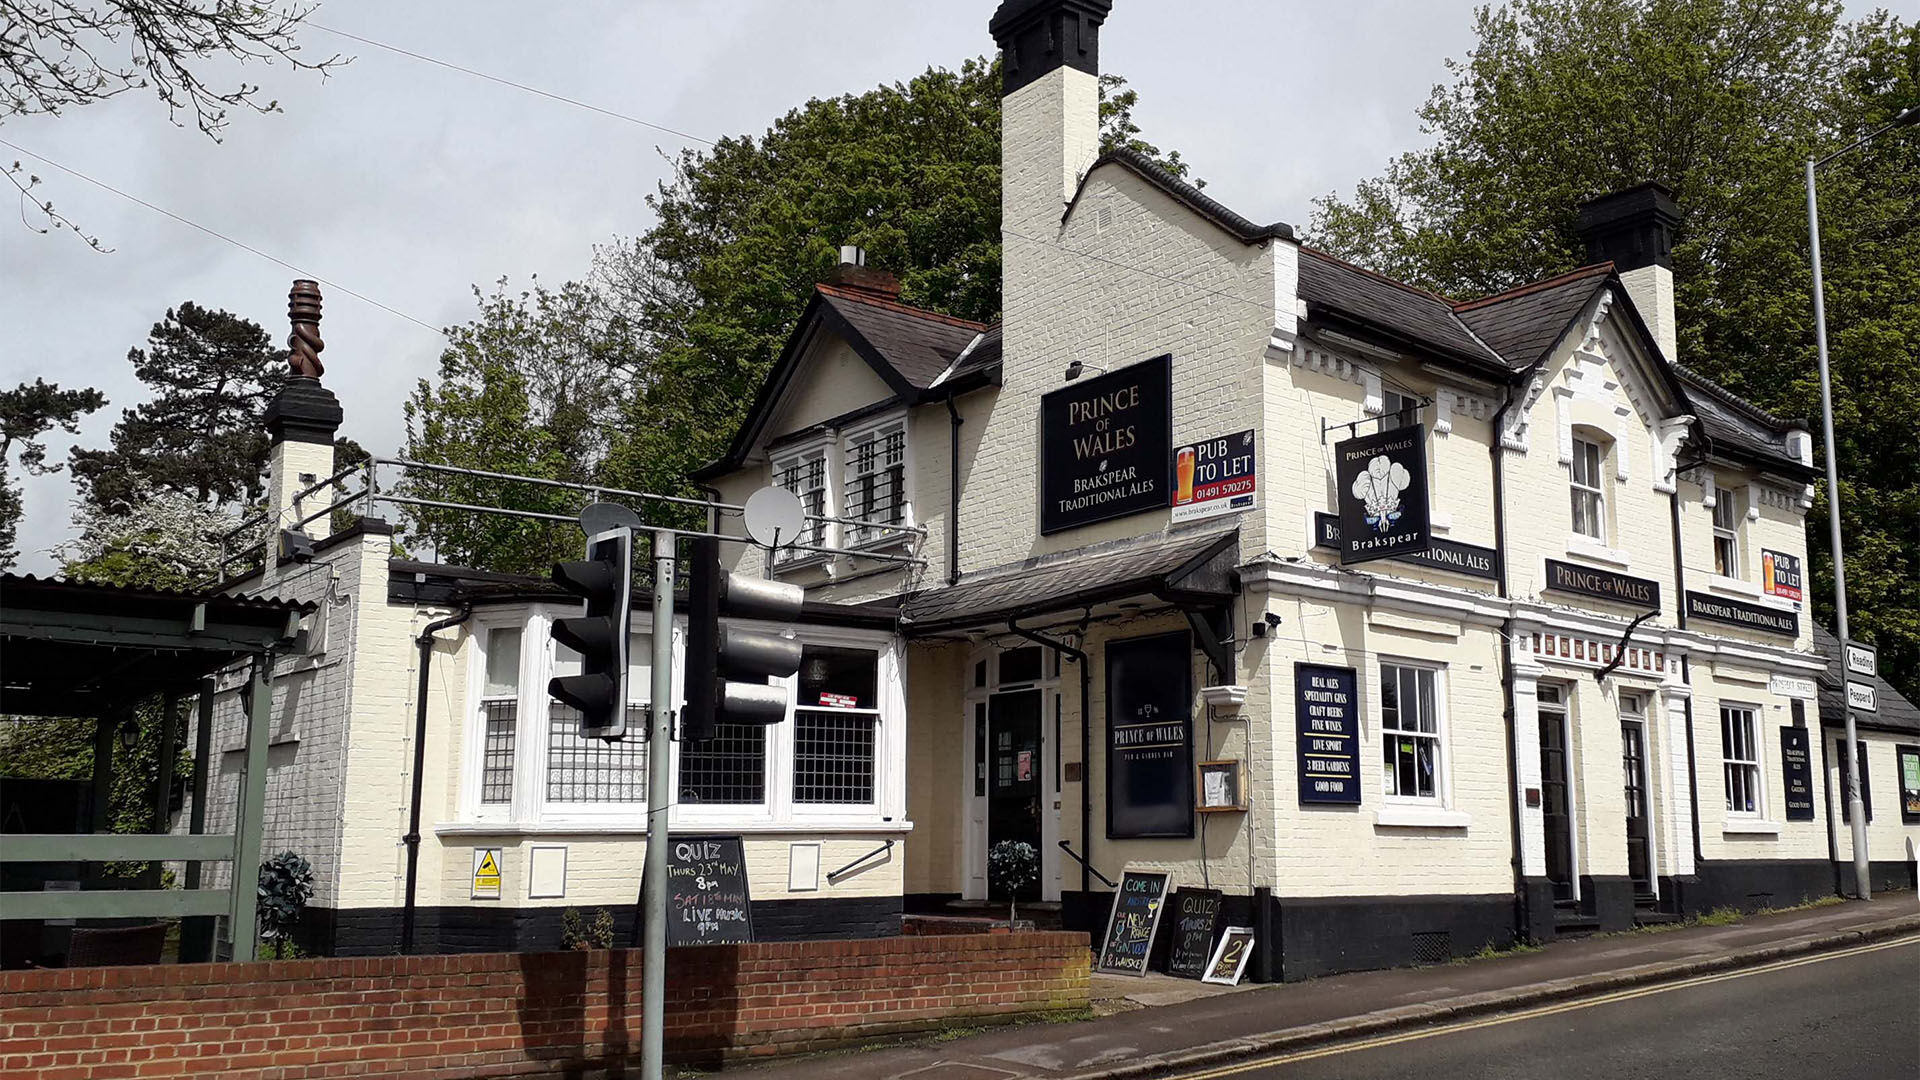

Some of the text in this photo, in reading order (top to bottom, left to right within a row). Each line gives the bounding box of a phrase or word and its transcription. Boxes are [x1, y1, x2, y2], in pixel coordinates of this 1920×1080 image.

[1069, 385, 1139, 426] PRINCE
[1096, 418, 1110, 432] OF
[1073, 426, 1136, 460] WALES
[1198, 440, 1228, 460] PUB
[1346, 448, 1376, 460] PRINCE
[1384, 440, 1412, 452] WALES
[1198, 455, 1251, 482] TO LET
[1074, 466, 1136, 494] BRAKSPEAR
[1059, 480, 1154, 512] TRADITIONAL ALES
[1196, 480, 1252, 498] 01491 570275
[1352, 532, 1418, 551] Brakspear
[1466, 554, 1490, 570] ALES
[1774, 555, 1790, 570] PUB
[1556, 566, 1650, 601] PRINCE OF WALES
[1775, 570, 1800, 587] TO LET
[1692, 599, 1792, 630] BRAKSPEAR TRADITIONAL ALES
[1852, 653, 1873, 670] Reading
[1312, 676, 1339, 689] REAL ALES
[1304, 690, 1347, 704] SPECIALITY GINS
[1850, 688, 1871, 703] Peppard
[1310, 705, 1343, 718] CRAFT BEERS
[1312, 720, 1342, 732] FINE WINES
[1114, 726, 1184, 744] PRINCE OF WALES
[1312, 739, 1342, 751] LIVE SPORT
[1307, 760, 1350, 772] 3 BEER GARDENS
[1315, 781, 1344, 792] GOOD FOOD
[676, 841, 721, 862] QUIZ
[668, 864, 696, 878] THURS
[720, 862, 738, 876] MAY
[1126, 879, 1160, 893] COME IN
[674, 892, 698, 909] SAT
[724, 893, 744, 904] MAY
[1183, 896, 1214, 914] QUIZ
[683, 906, 712, 922] LIVE
[1127, 913, 1146, 928] NEW
